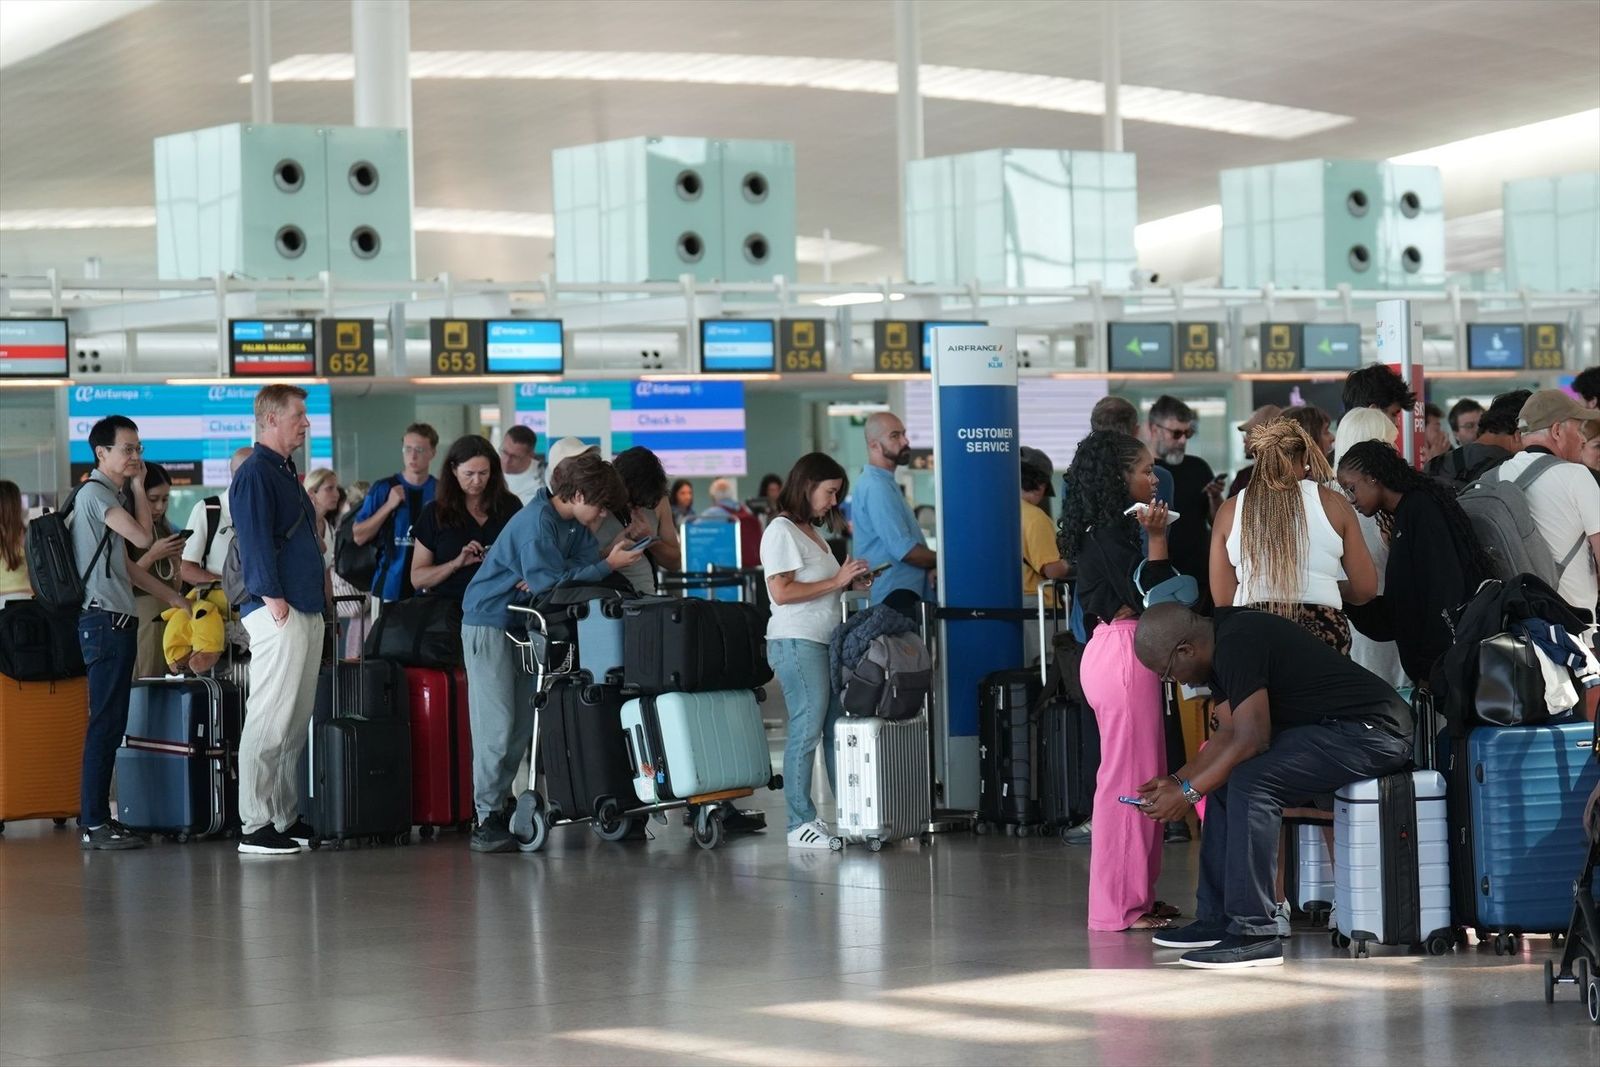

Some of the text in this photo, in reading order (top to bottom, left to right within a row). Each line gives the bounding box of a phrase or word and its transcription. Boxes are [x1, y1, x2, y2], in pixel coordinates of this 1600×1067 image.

[330, 353, 368, 373] 652
[438, 352, 476, 372] 653
[786, 350, 822, 369] 654
[880, 351, 913, 369] 655
[1183, 351, 1215, 369] 656
[1266, 351, 1295, 369] 657
[95, 388, 139, 401] AirEuropa
[1414, 401, 1424, 417] SK
[209, 420, 251, 432] Check-
[957, 427, 1013, 439] CUSTOMER
[966, 441, 1010, 453] SERVICE
